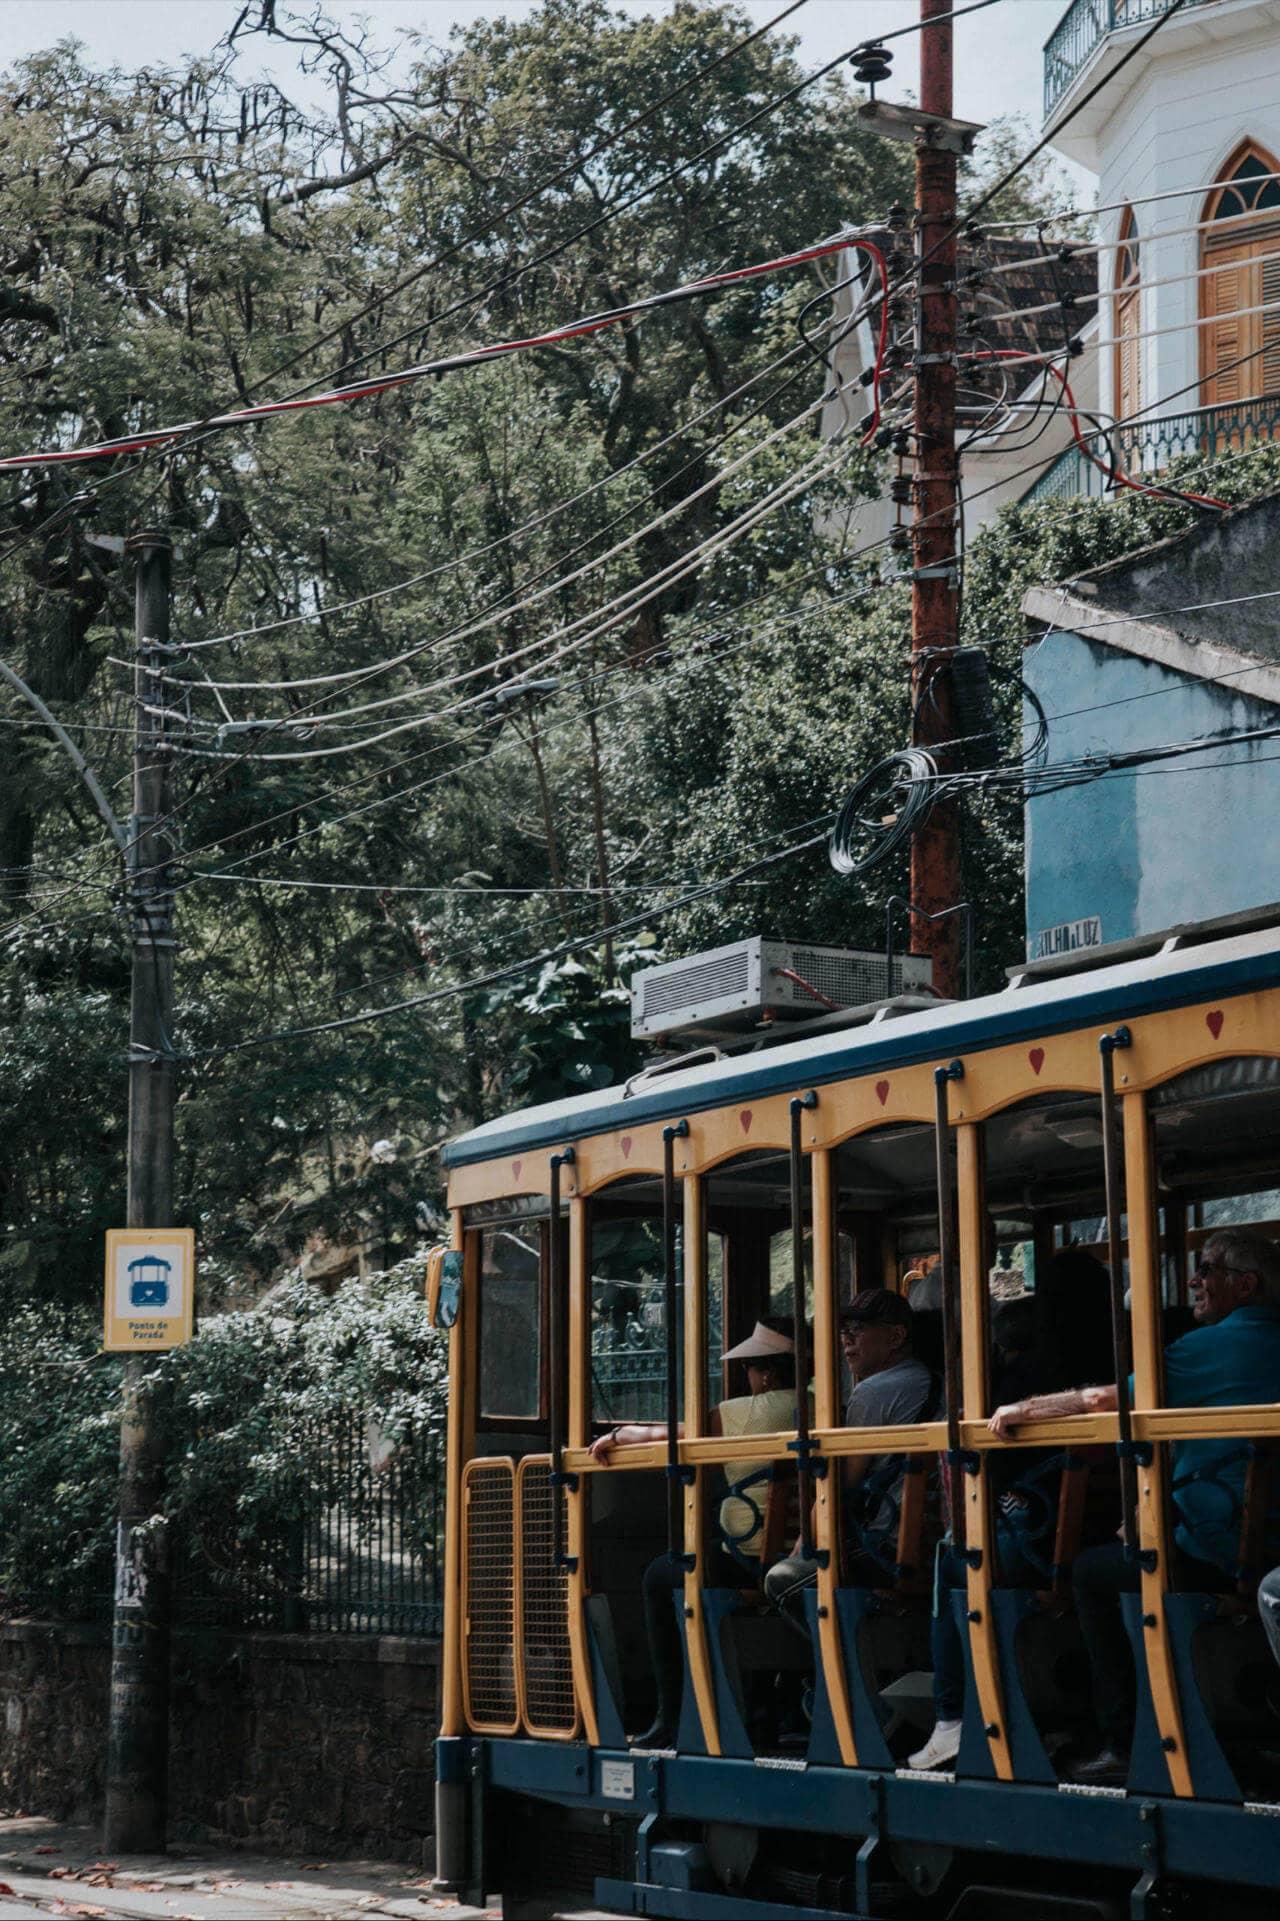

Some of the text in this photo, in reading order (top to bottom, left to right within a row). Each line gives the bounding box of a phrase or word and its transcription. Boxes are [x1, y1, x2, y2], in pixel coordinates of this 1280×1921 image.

[128, 1320, 168, 1330] Ponto de
[133, 1330, 164, 1339] Parada
